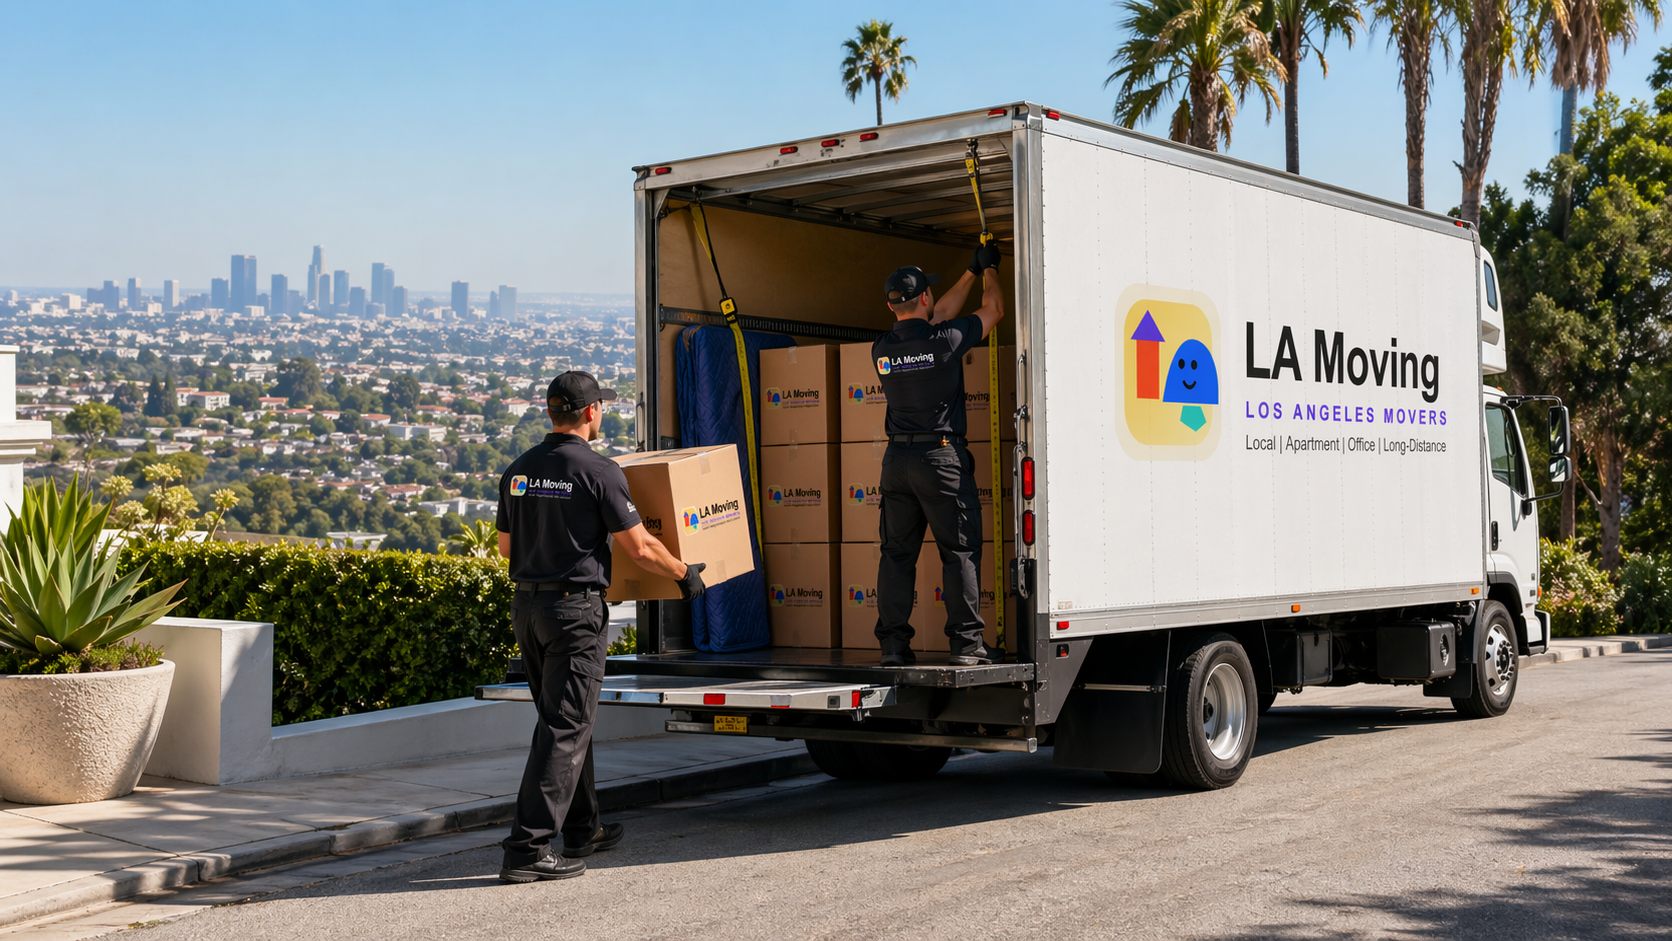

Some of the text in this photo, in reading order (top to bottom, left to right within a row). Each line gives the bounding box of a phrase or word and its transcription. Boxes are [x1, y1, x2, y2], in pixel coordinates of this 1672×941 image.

[891, 357, 903, 366] LA
[903, 353, 934, 364] Moving
[1246, 321, 1439, 403] LA Moving
[782, 388, 819, 399] LA Moving
[866, 385, 876, 395] LA
[1246, 401, 1446, 425] LOS ANGELES MOVERS
[1246, 435, 1275, 450] Local
[1286, 436, 1339, 454] Apartment
[1348, 437, 1375, 451] Office
[1384, 438, 1446, 455] Long-Distance
[529, 478, 541, 488] LA
[542, 479, 573, 493] Moving
[866, 486, 877, 496] LA
[783, 488, 821, 499] LA Moving
[699, 506, 711, 519] LA
[711, 499, 739, 515] Moving
[785, 588, 795, 597] LA
[866, 588, 877, 598] LA
